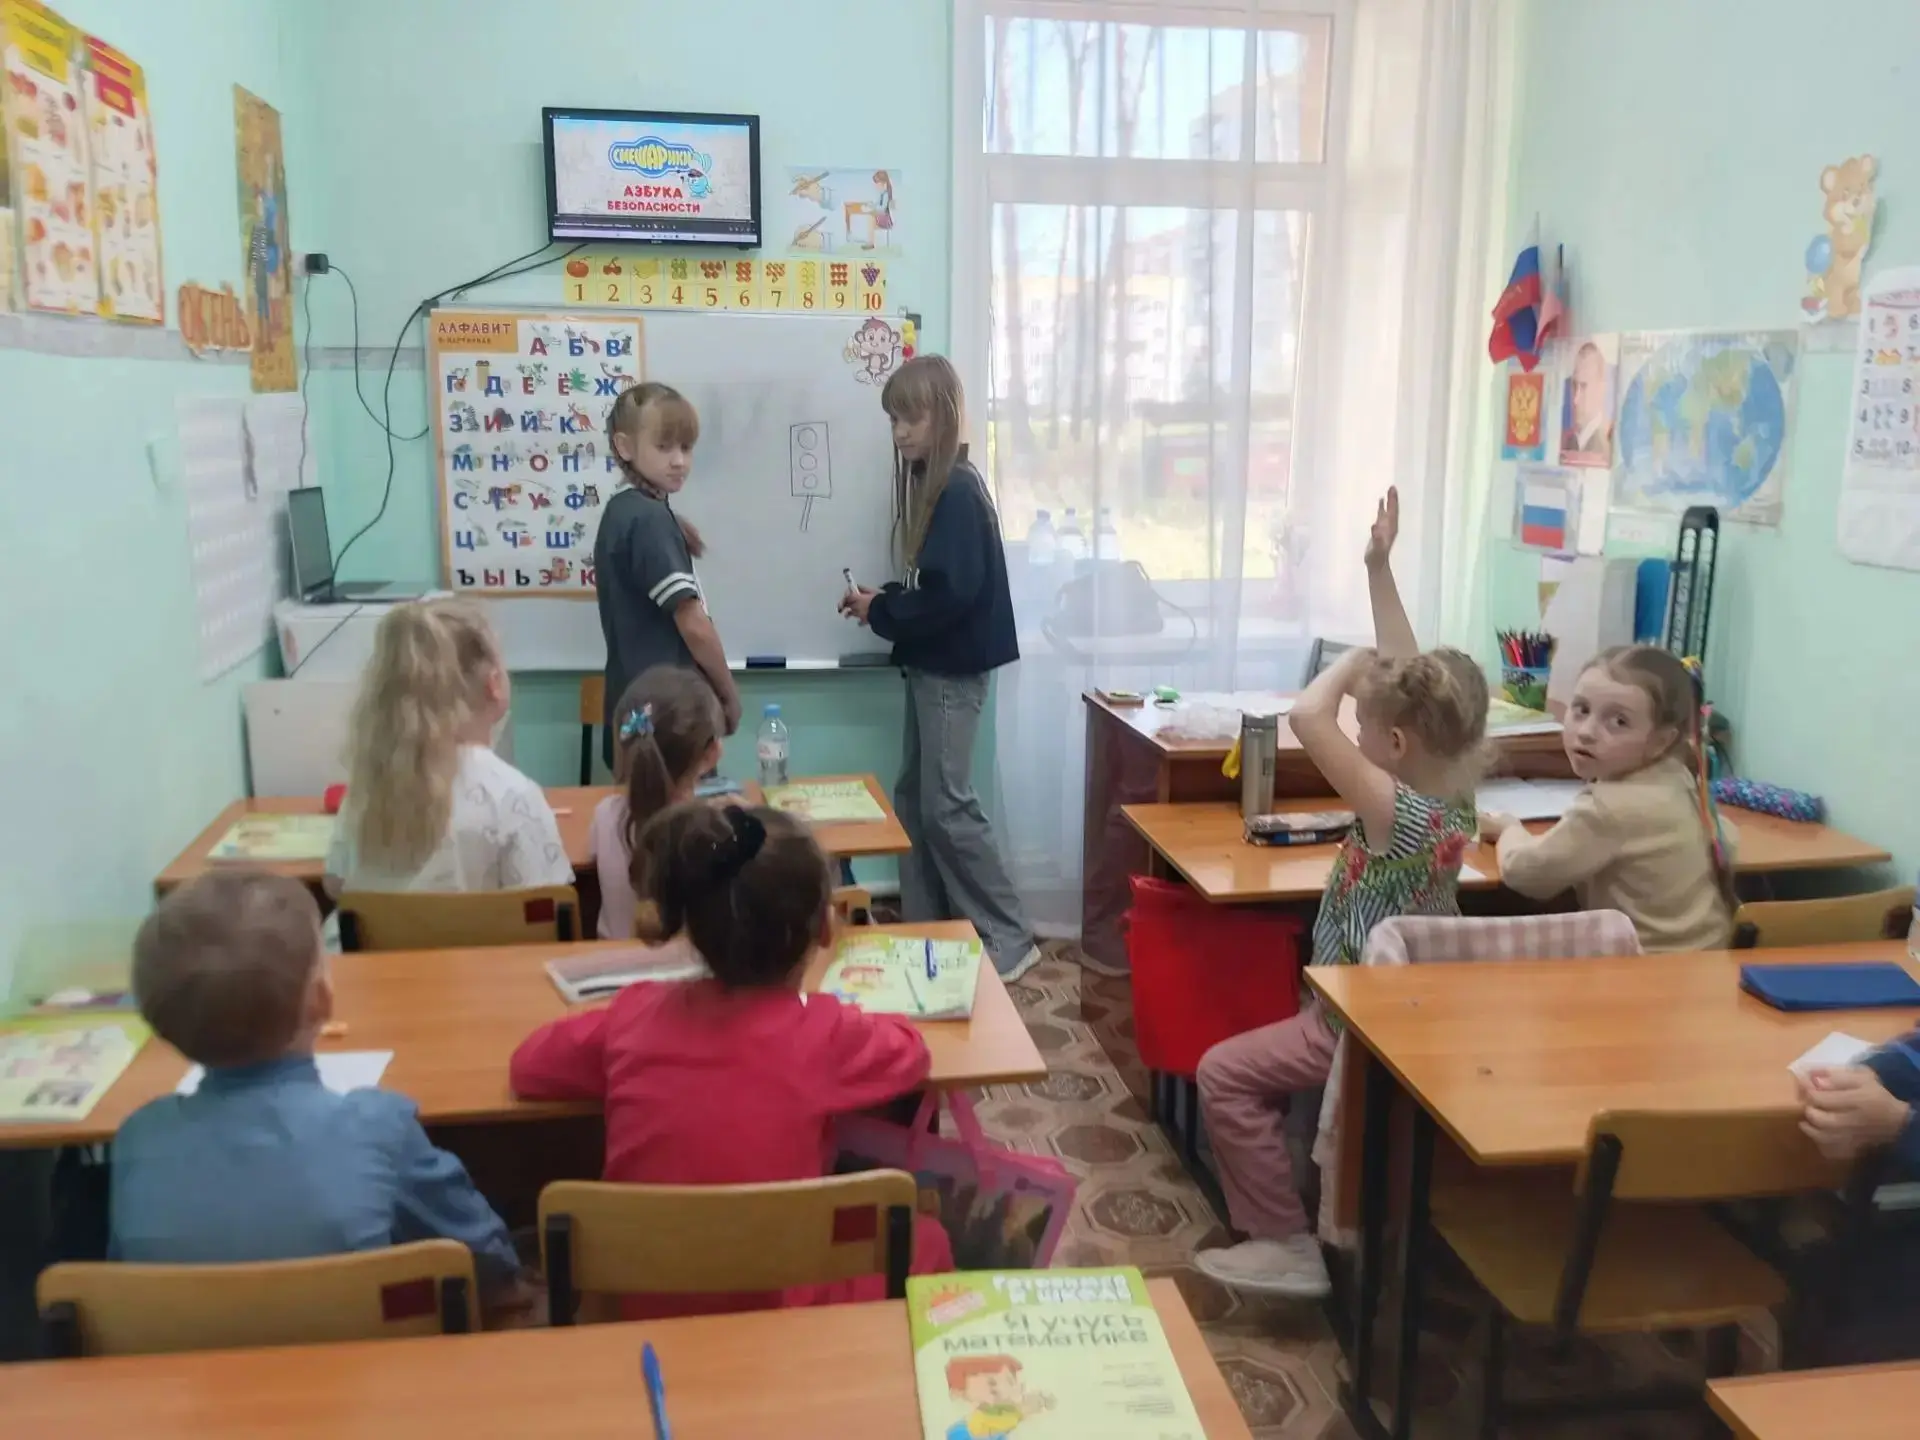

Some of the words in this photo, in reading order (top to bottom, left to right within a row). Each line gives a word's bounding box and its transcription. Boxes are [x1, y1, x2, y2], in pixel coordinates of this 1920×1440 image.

[623, 185, 683, 199] АЗБУКА
[607, 200, 700, 213] БЕЗОПАСНОСТИ
[574, 284, 584, 301] 1
[608, 284, 619, 302] 2
[640, 285, 652, 304] 3
[672, 285, 684, 305] 4
[706, 287, 718, 306] 5
[739, 288, 750, 307] 6
[771, 290, 782, 308] 7
[803, 291, 814, 309] 8
[835, 291, 845, 309] 9
[863, 292, 882, 310] 10
[438, 322, 511, 334] АЛФАВИТ
[529, 337, 548, 356] А
[569, 338, 585, 356] Б
[606, 339, 621, 357] В
[484, 375, 504, 398] Д
[523, 376, 534, 395] Е
[558, 373, 570, 396] Ё
[594, 378, 618, 397] Ж
[449, 414, 463, 433] З
[484, 415, 501, 433] И
[521, 410, 538, 433] Й
[559, 416, 576, 434] К
[452, 454, 474, 472] М
[491, 454, 509, 472] Н
[529, 454, 548, 472] О
[562, 454, 579, 472] П
[454, 492, 469, 510] С
[564, 492, 586, 511] Ф
[455, 531, 475, 551] Ц
[502, 531, 518, 549] Ч
[545, 531, 570, 549] Ш
[456, 568, 476, 586] Ъ
[483, 568, 505, 586] Ы
[515, 569, 530, 586] Ь
[538, 568, 553, 587] Э
